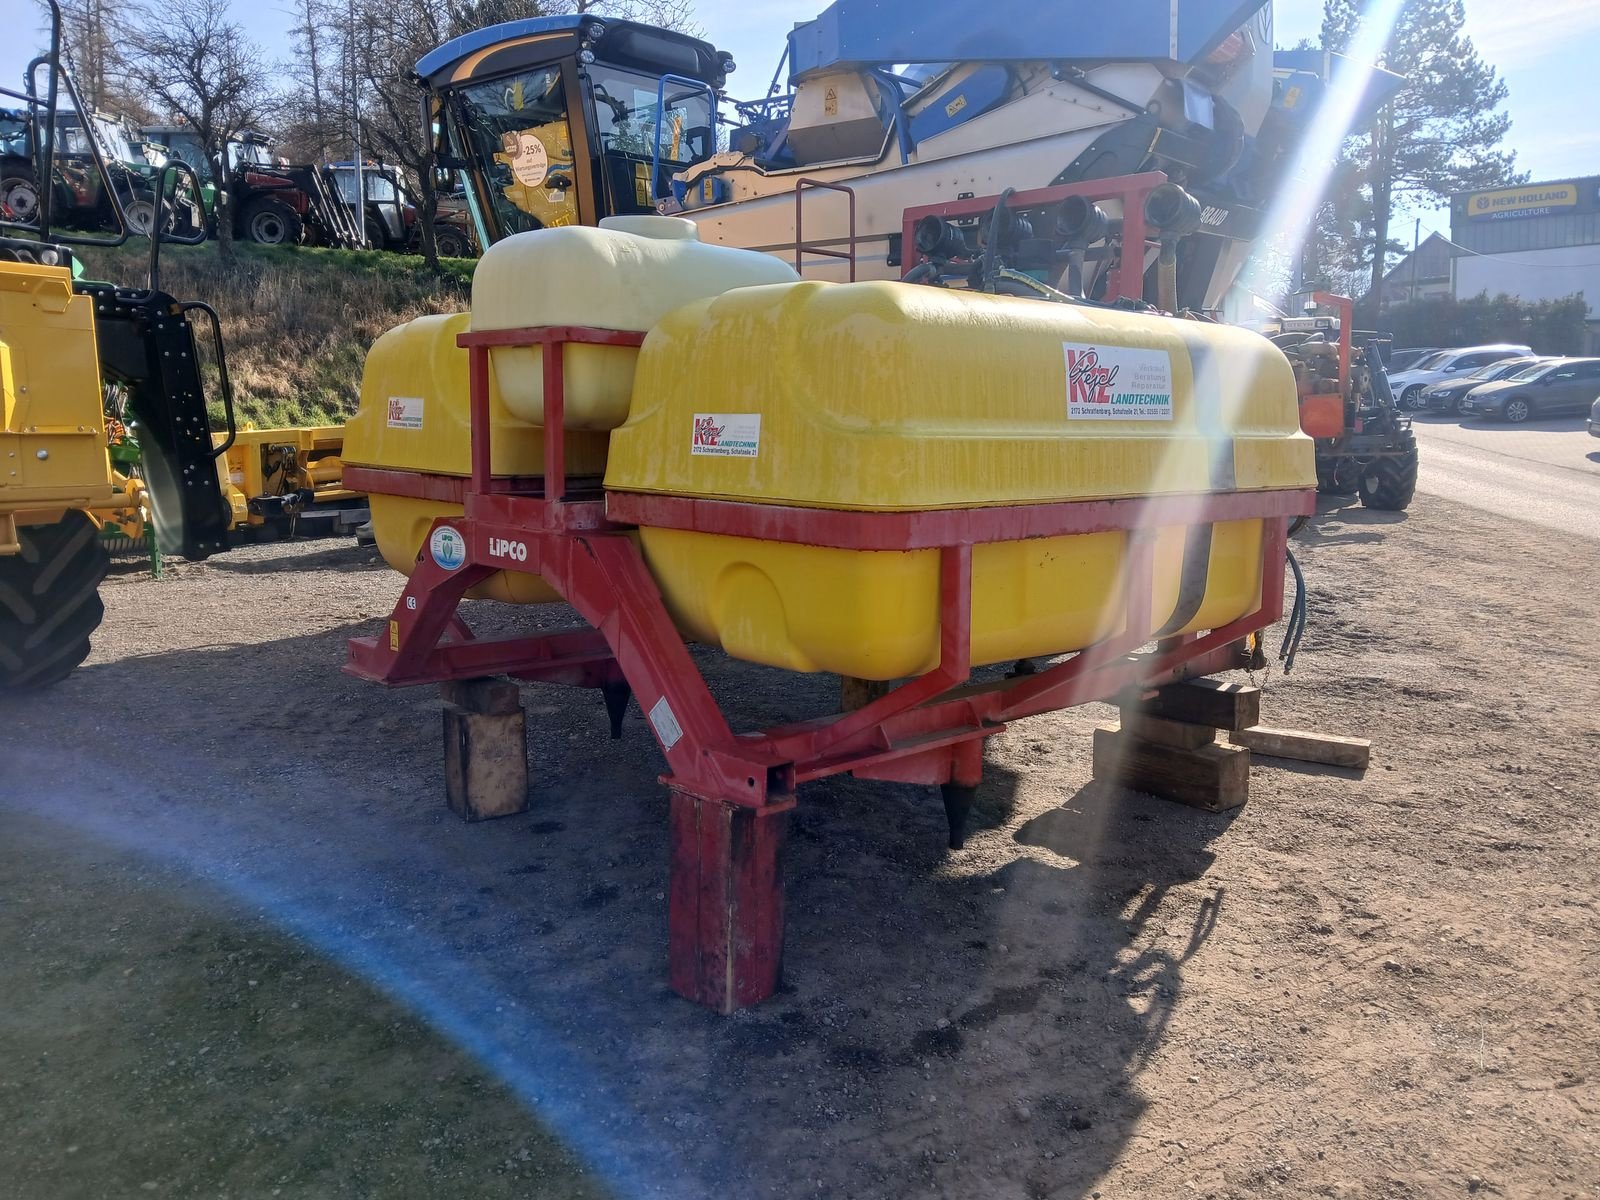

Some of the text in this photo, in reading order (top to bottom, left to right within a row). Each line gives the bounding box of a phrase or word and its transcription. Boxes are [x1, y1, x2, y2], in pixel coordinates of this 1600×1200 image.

[523, 144, 541, 155] -25%
[1492, 191, 1568, 206] NEW HOLLAND
[1492, 207, 1550, 219] AGRICULTURE
[1110, 393, 1170, 405] LANDTECHNIK
[718, 440, 757, 448] LANDTECHNIK
